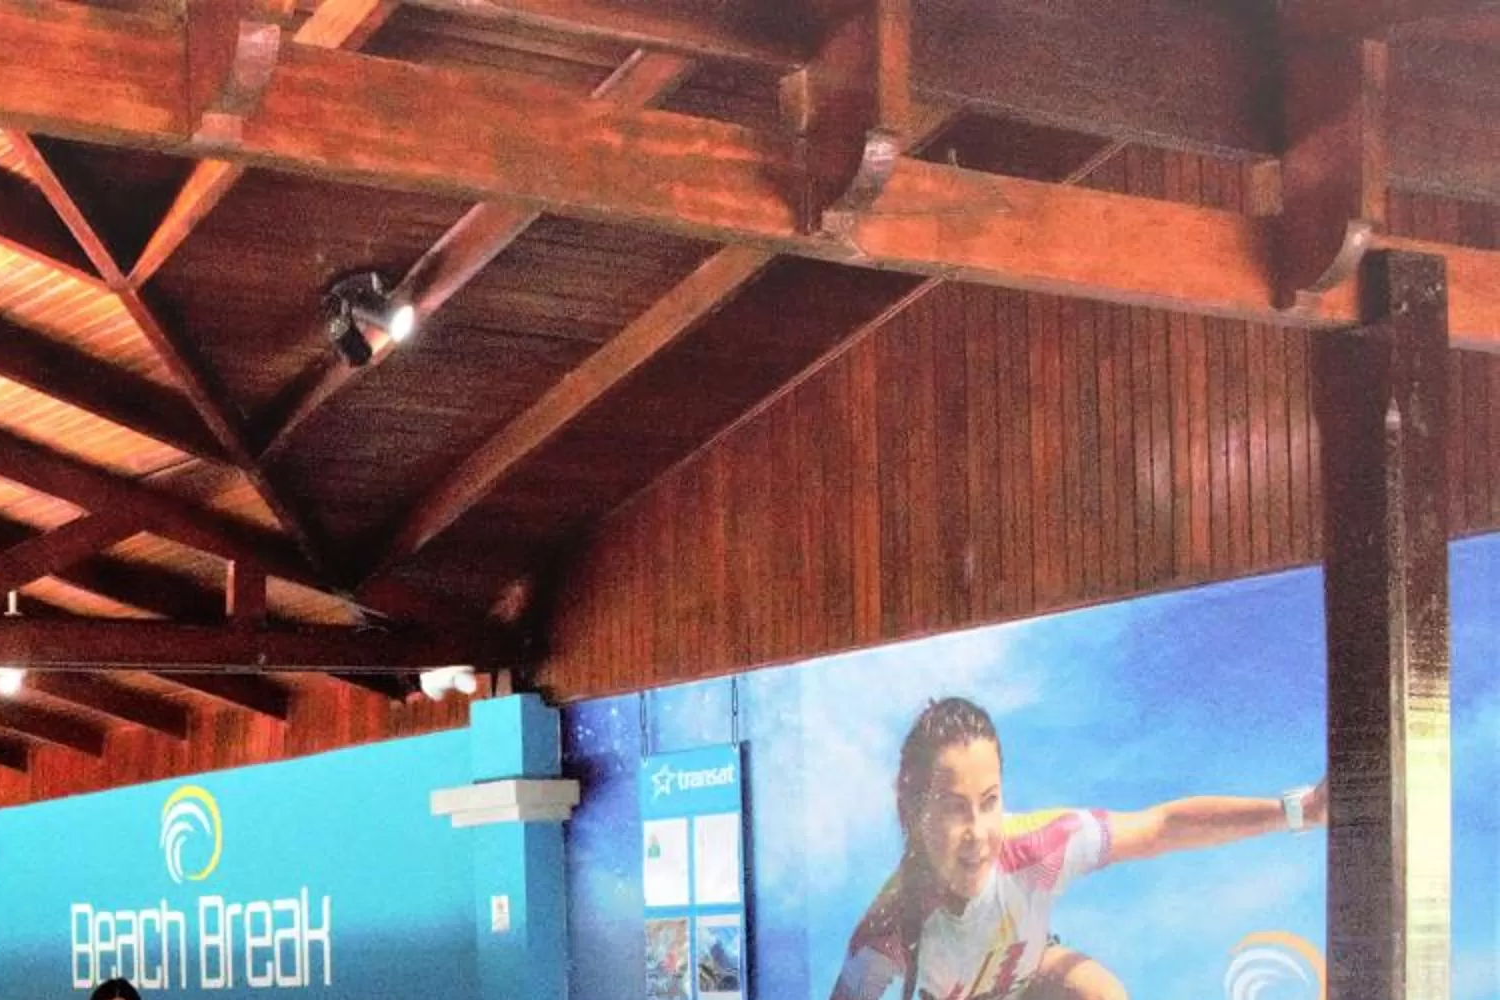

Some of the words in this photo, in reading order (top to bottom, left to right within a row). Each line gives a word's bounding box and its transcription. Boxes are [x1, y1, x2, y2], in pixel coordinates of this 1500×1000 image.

[677, 763, 735, 790] transat
[71, 898, 186, 989] Beach
[200, 887, 331, 988] Break
